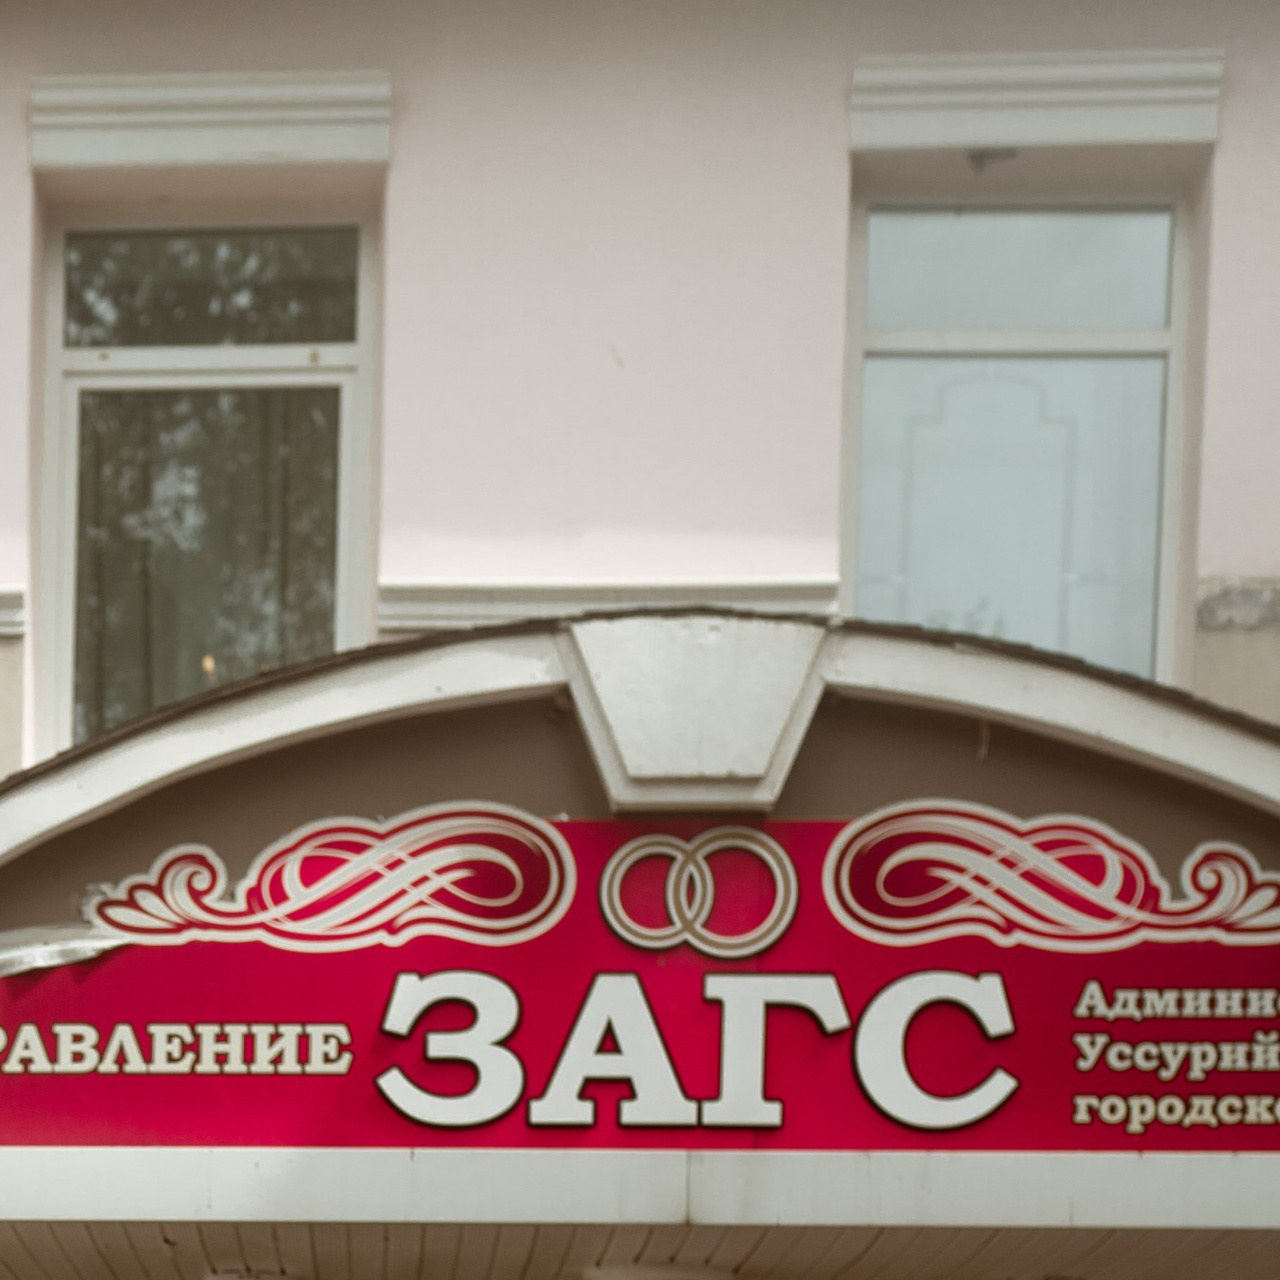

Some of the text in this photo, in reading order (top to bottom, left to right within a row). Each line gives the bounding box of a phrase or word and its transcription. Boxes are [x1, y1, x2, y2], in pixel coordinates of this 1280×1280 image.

[1074, 979, 1280, 1021] Админи
[376, 970, 1018, 1129] ЗАГС
[1073, 1094, 1280, 1134] городск
